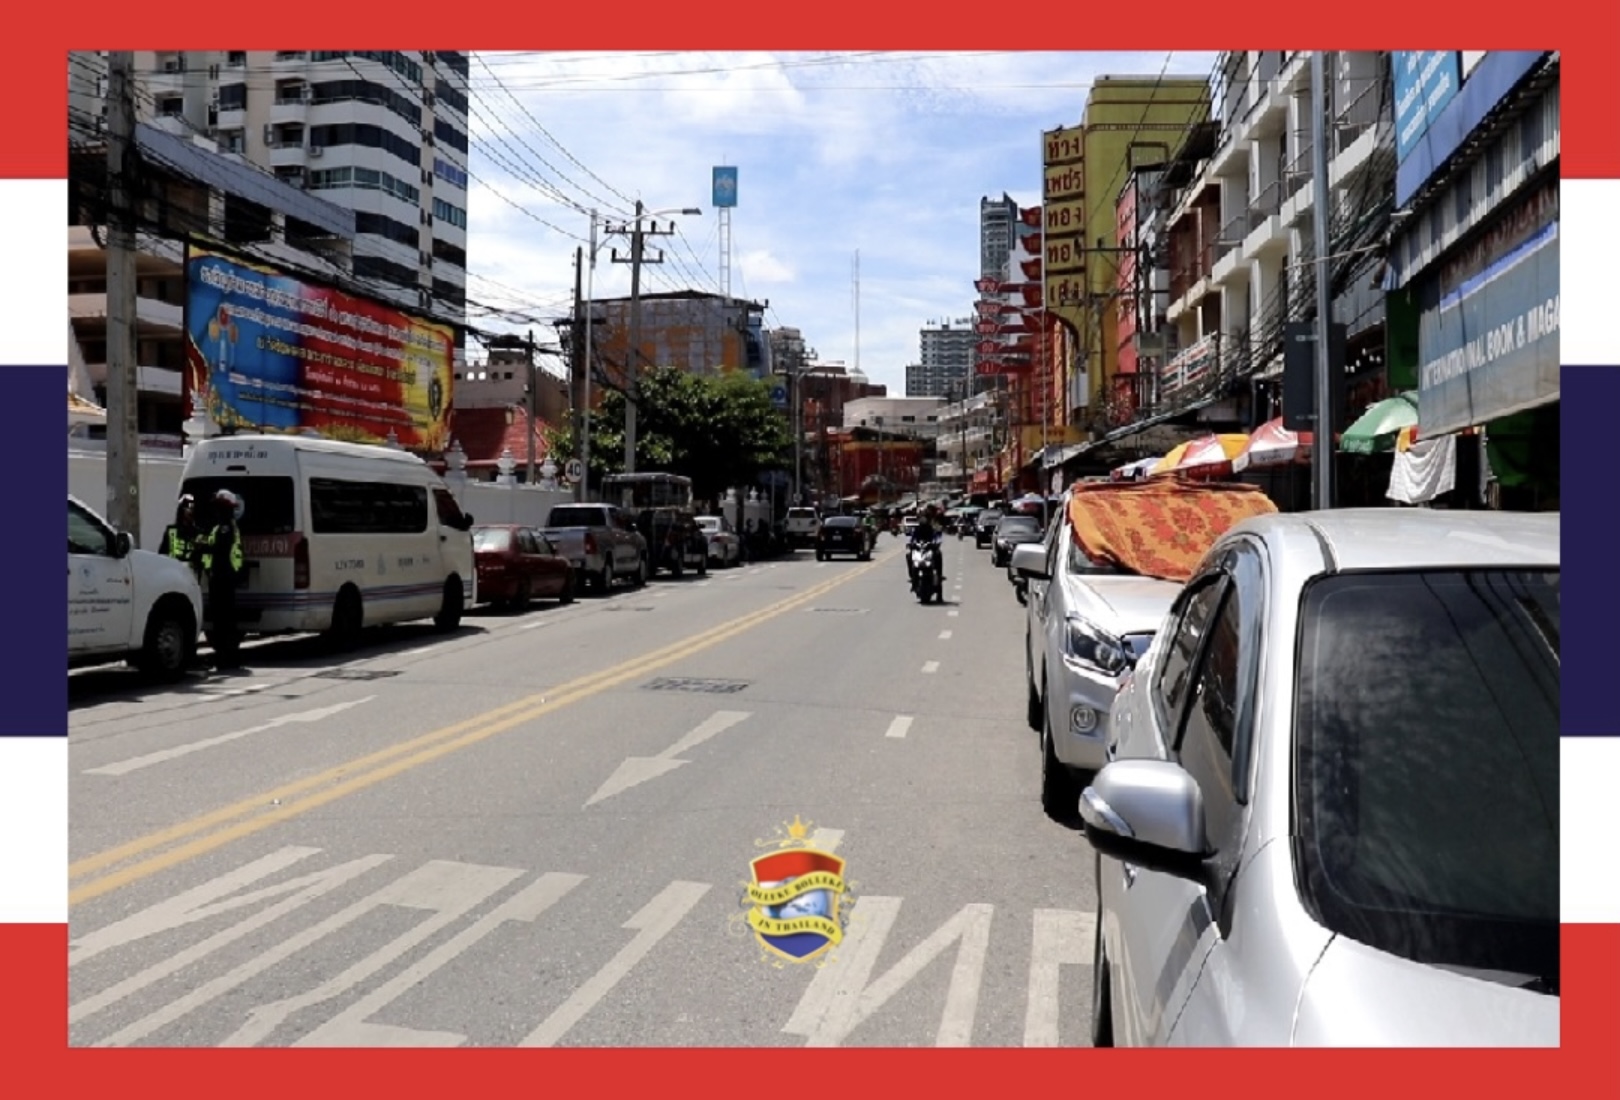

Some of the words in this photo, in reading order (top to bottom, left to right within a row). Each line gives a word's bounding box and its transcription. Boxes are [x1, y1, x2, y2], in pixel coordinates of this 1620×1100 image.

[1047, 131, 1080, 159] ห้าง
[1047, 206, 1082, 228] ทอง
[1421, 337, 1486, 391] INTERNATIONAL
[1488, 319, 1515, 361] BOOK
[1517, 314, 1526, 350] &
[567, 462, 582, 476] 40
